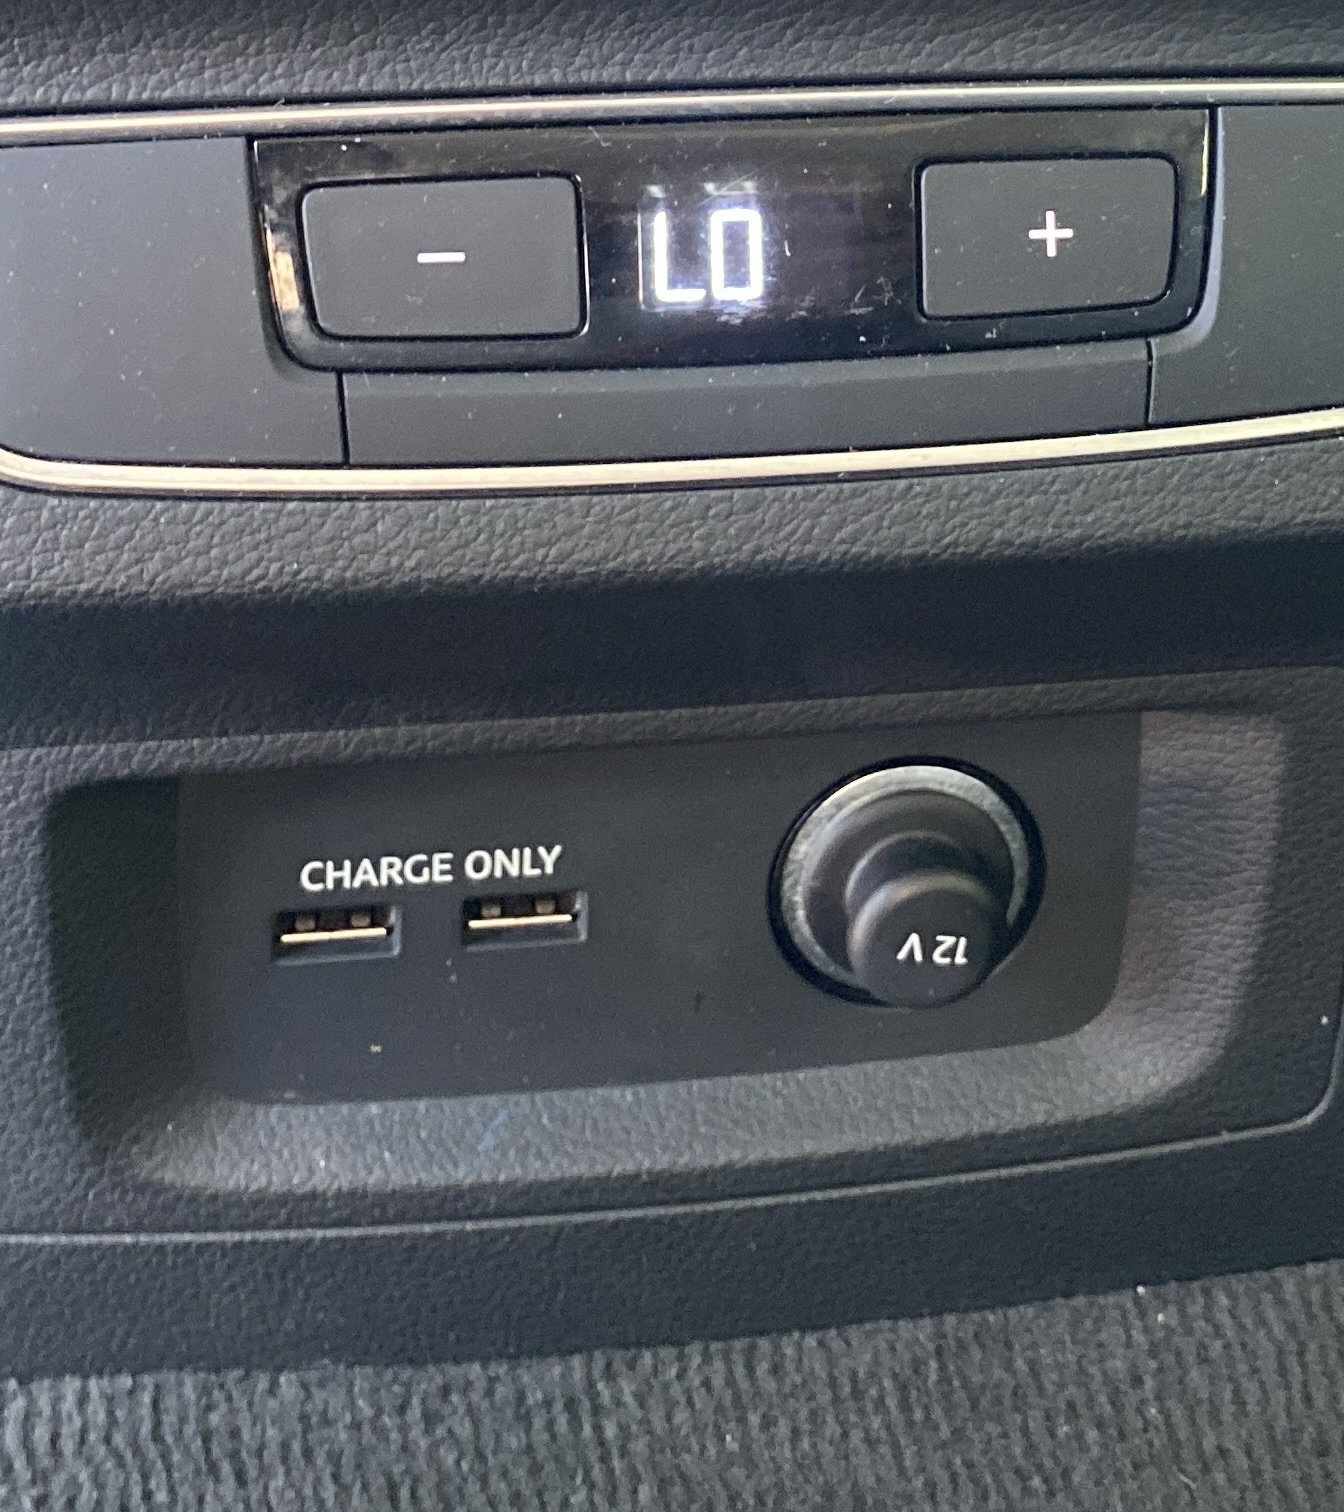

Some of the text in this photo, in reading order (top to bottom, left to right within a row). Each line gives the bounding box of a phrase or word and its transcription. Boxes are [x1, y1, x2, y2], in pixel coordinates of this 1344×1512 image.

[653, 208, 763, 303] LO
[300, 844, 562, 891] CHARGE ONLY
[896, 932, 969, 965] 12 V
